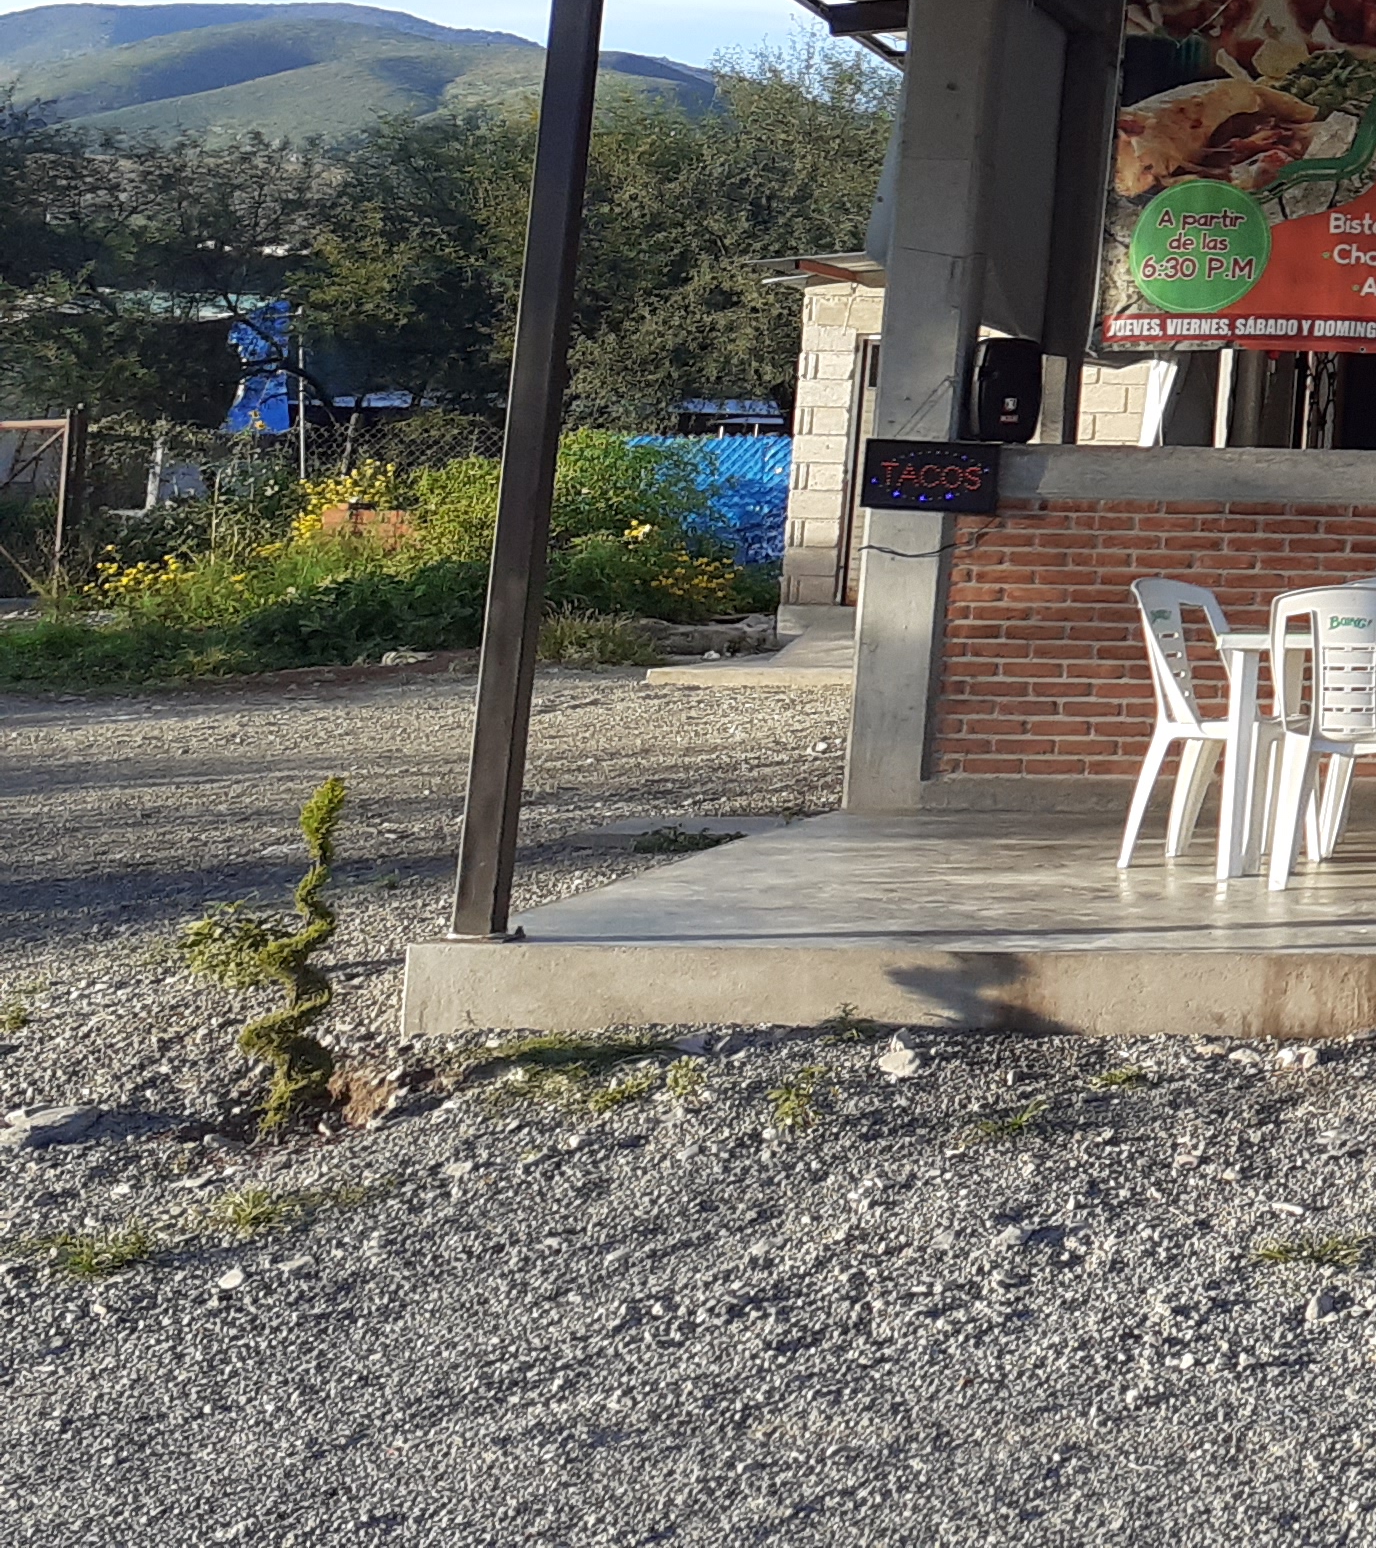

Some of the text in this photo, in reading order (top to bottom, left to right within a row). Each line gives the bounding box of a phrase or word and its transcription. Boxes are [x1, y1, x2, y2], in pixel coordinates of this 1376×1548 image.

[1157, 209, 1246, 231] A partir
[1168, 233, 1229, 252] de las
[1141, 255, 1255, 280] 6:30 P.M
[1107, 318, 1162, 337] JUEVES,
[1167, 318, 1232, 336] VIERNES,
[1235, 316, 1297, 336] SÁBADO
[1301, 320, 1312, 336] Y
[880, 460, 982, 490] TACOS
